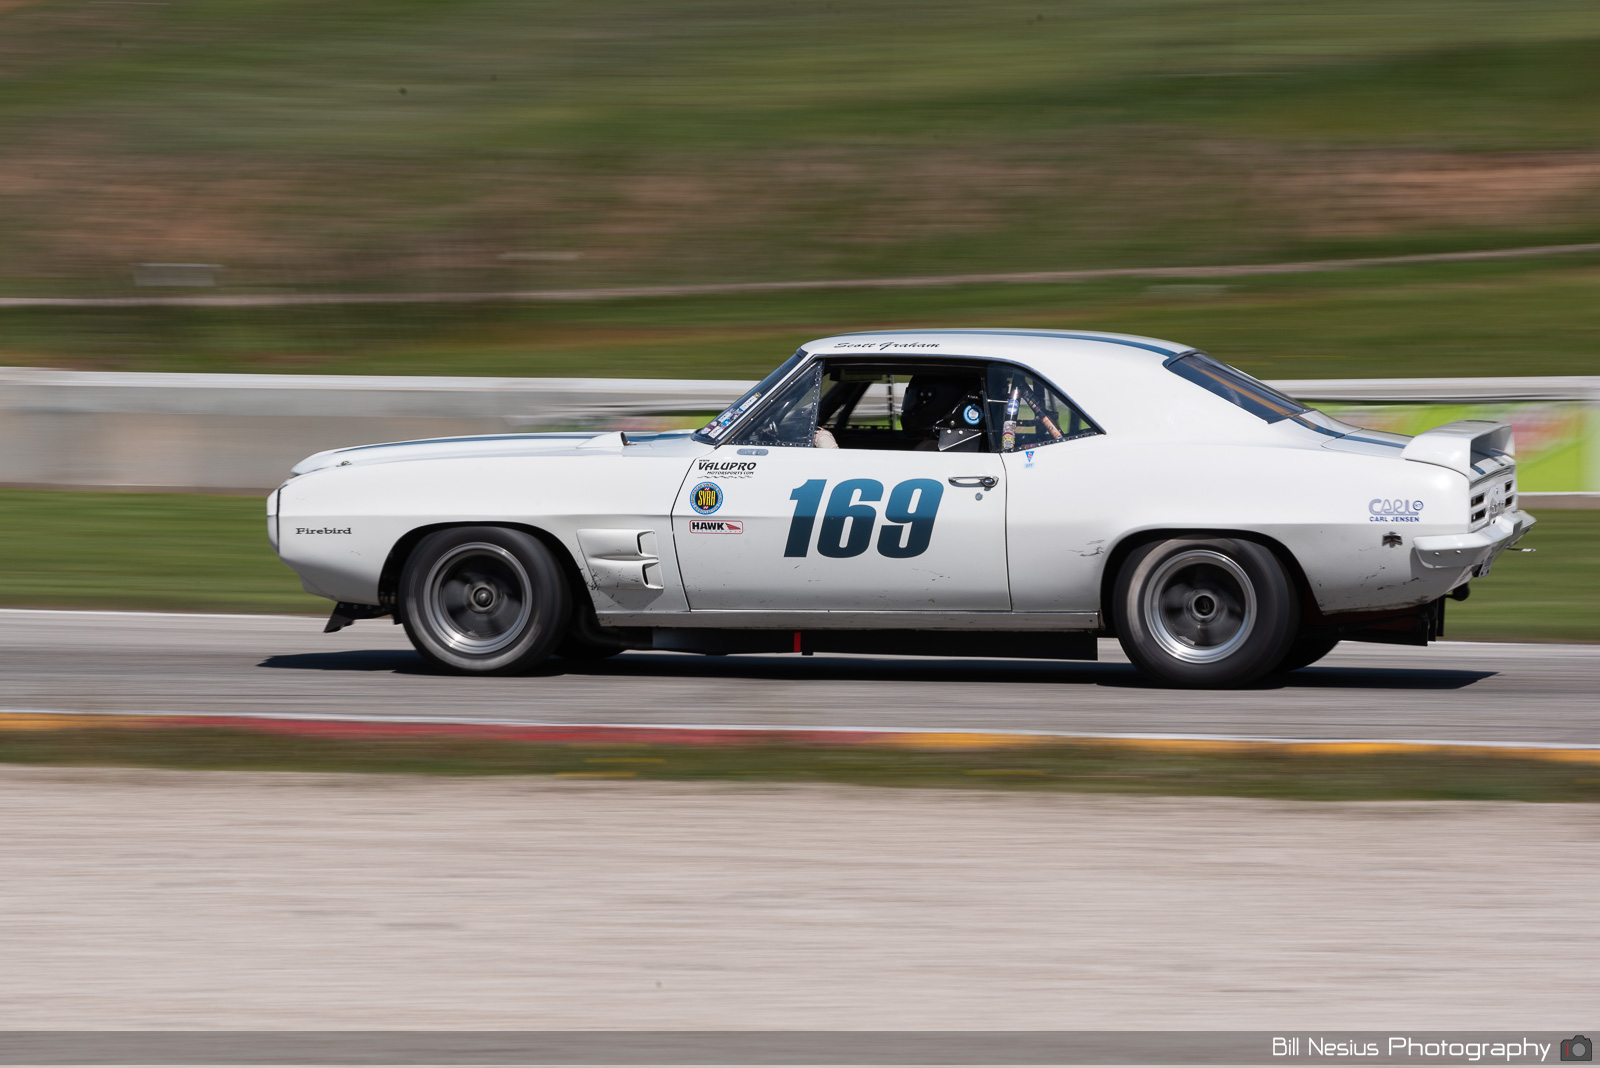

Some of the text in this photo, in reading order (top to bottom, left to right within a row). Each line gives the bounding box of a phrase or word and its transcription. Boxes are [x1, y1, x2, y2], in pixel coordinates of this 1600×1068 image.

[879, 341, 940, 351] Graham
[698, 462, 757, 471] VALUPRO
[697, 490, 716, 506] SVRA
[1368, 498, 1419, 516] CARL
[784, 478, 944, 558] 169
[295, 527, 352, 535] Firebird
[692, 522, 725, 531] HAWK
